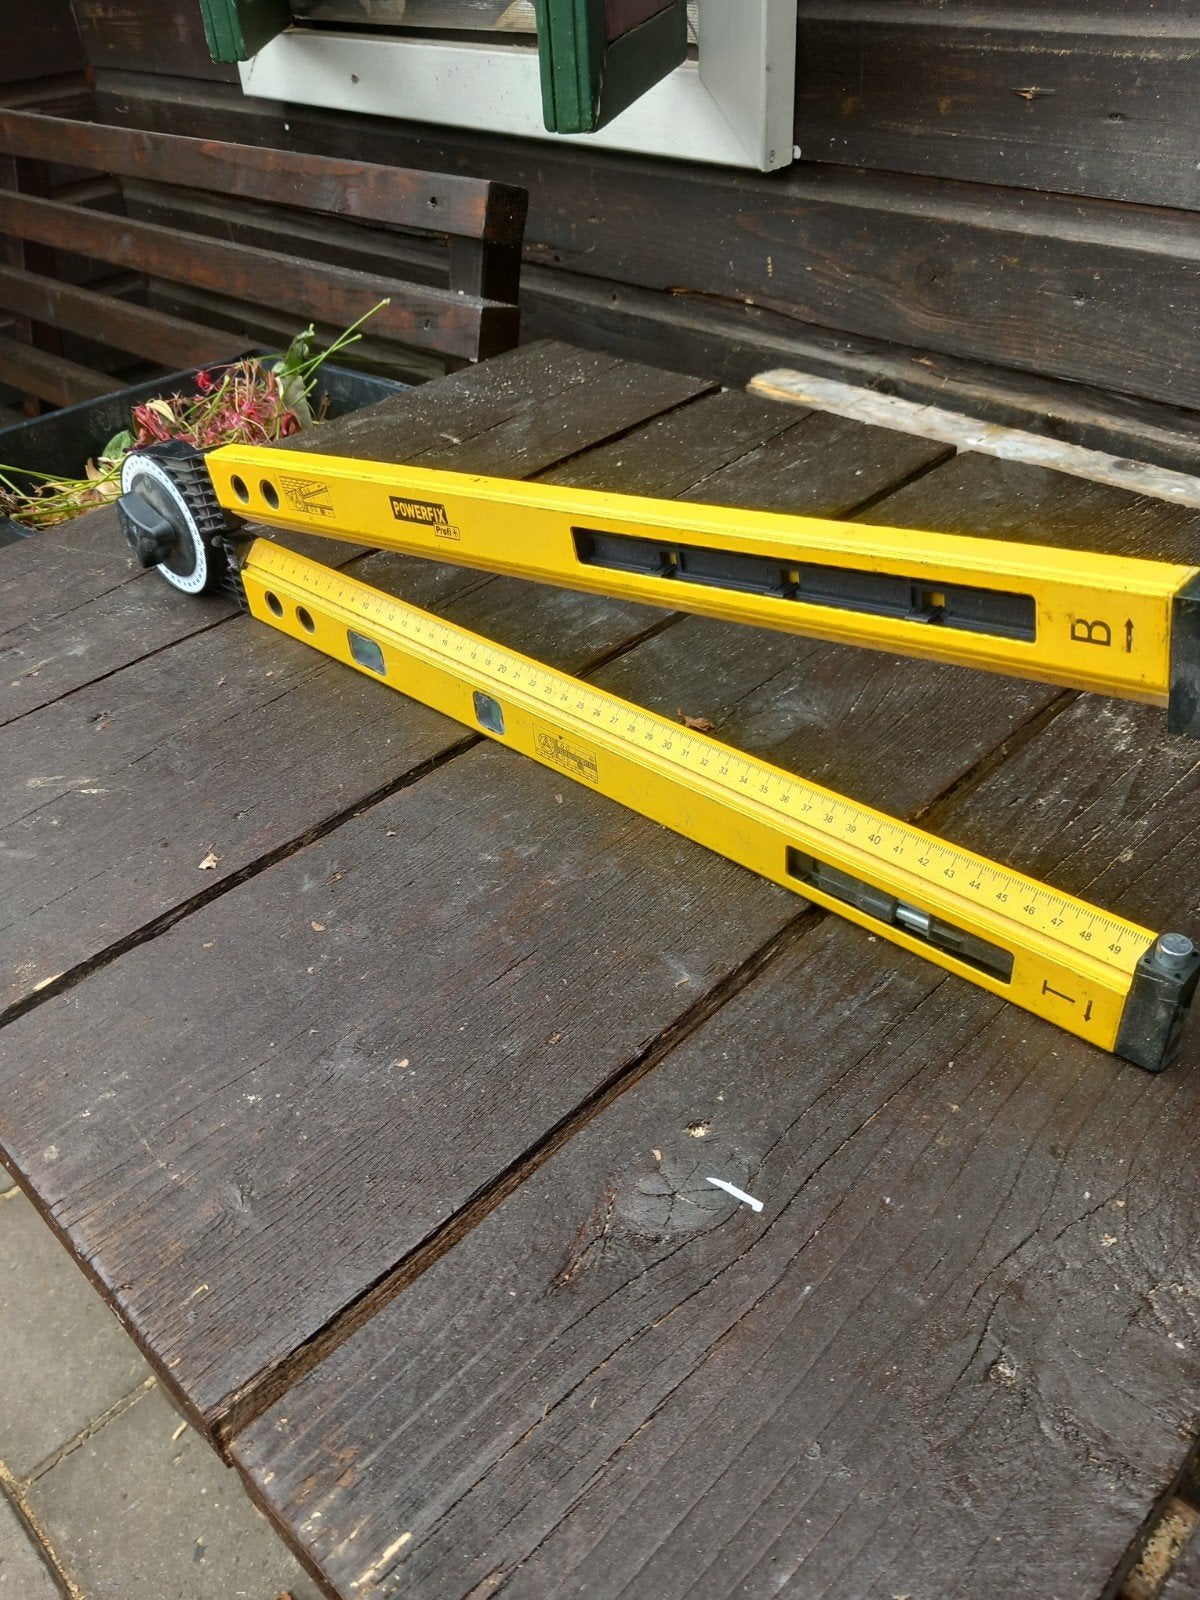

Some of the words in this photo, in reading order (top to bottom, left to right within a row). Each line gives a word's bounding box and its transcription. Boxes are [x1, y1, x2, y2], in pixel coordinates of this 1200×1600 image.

[392, 500, 446, 524] POWERFIX
[436, 525, 452, 536] Profi
[1070, 618, 1111, 646] B
[497, 664, 507, 673] 20
[592, 708, 601, 716] 26
[627, 724, 636, 733] 28
[644, 732, 653, 741] 29
[661, 740, 672, 750] 30
[681, 749, 690, 757] 31
[699, 758, 709, 766] 32
[718, 767, 728, 775] 33
[739, 776, 748, 784] 34
[759, 784, 768, 794] 35
[780, 794, 790, 803] 36
[801, 804, 812, 812] 37
[823, 813, 834, 823] 38
[845, 824, 856, 834] 39
[867, 833, 882, 845] 40
[893, 846, 903, 855] 41
[918, 857, 930, 867] 42
[943, 868, 955, 878] 43
[969, 880, 981, 890] 44
[996, 892, 1008, 903] 45
[1022, 904, 1035, 915] 46
[1050, 917, 1064, 927] 47
[1079, 930, 1092, 941] 48
[1108, 943, 1122, 955] 49
[1042, 980, 1076, 1004] T
